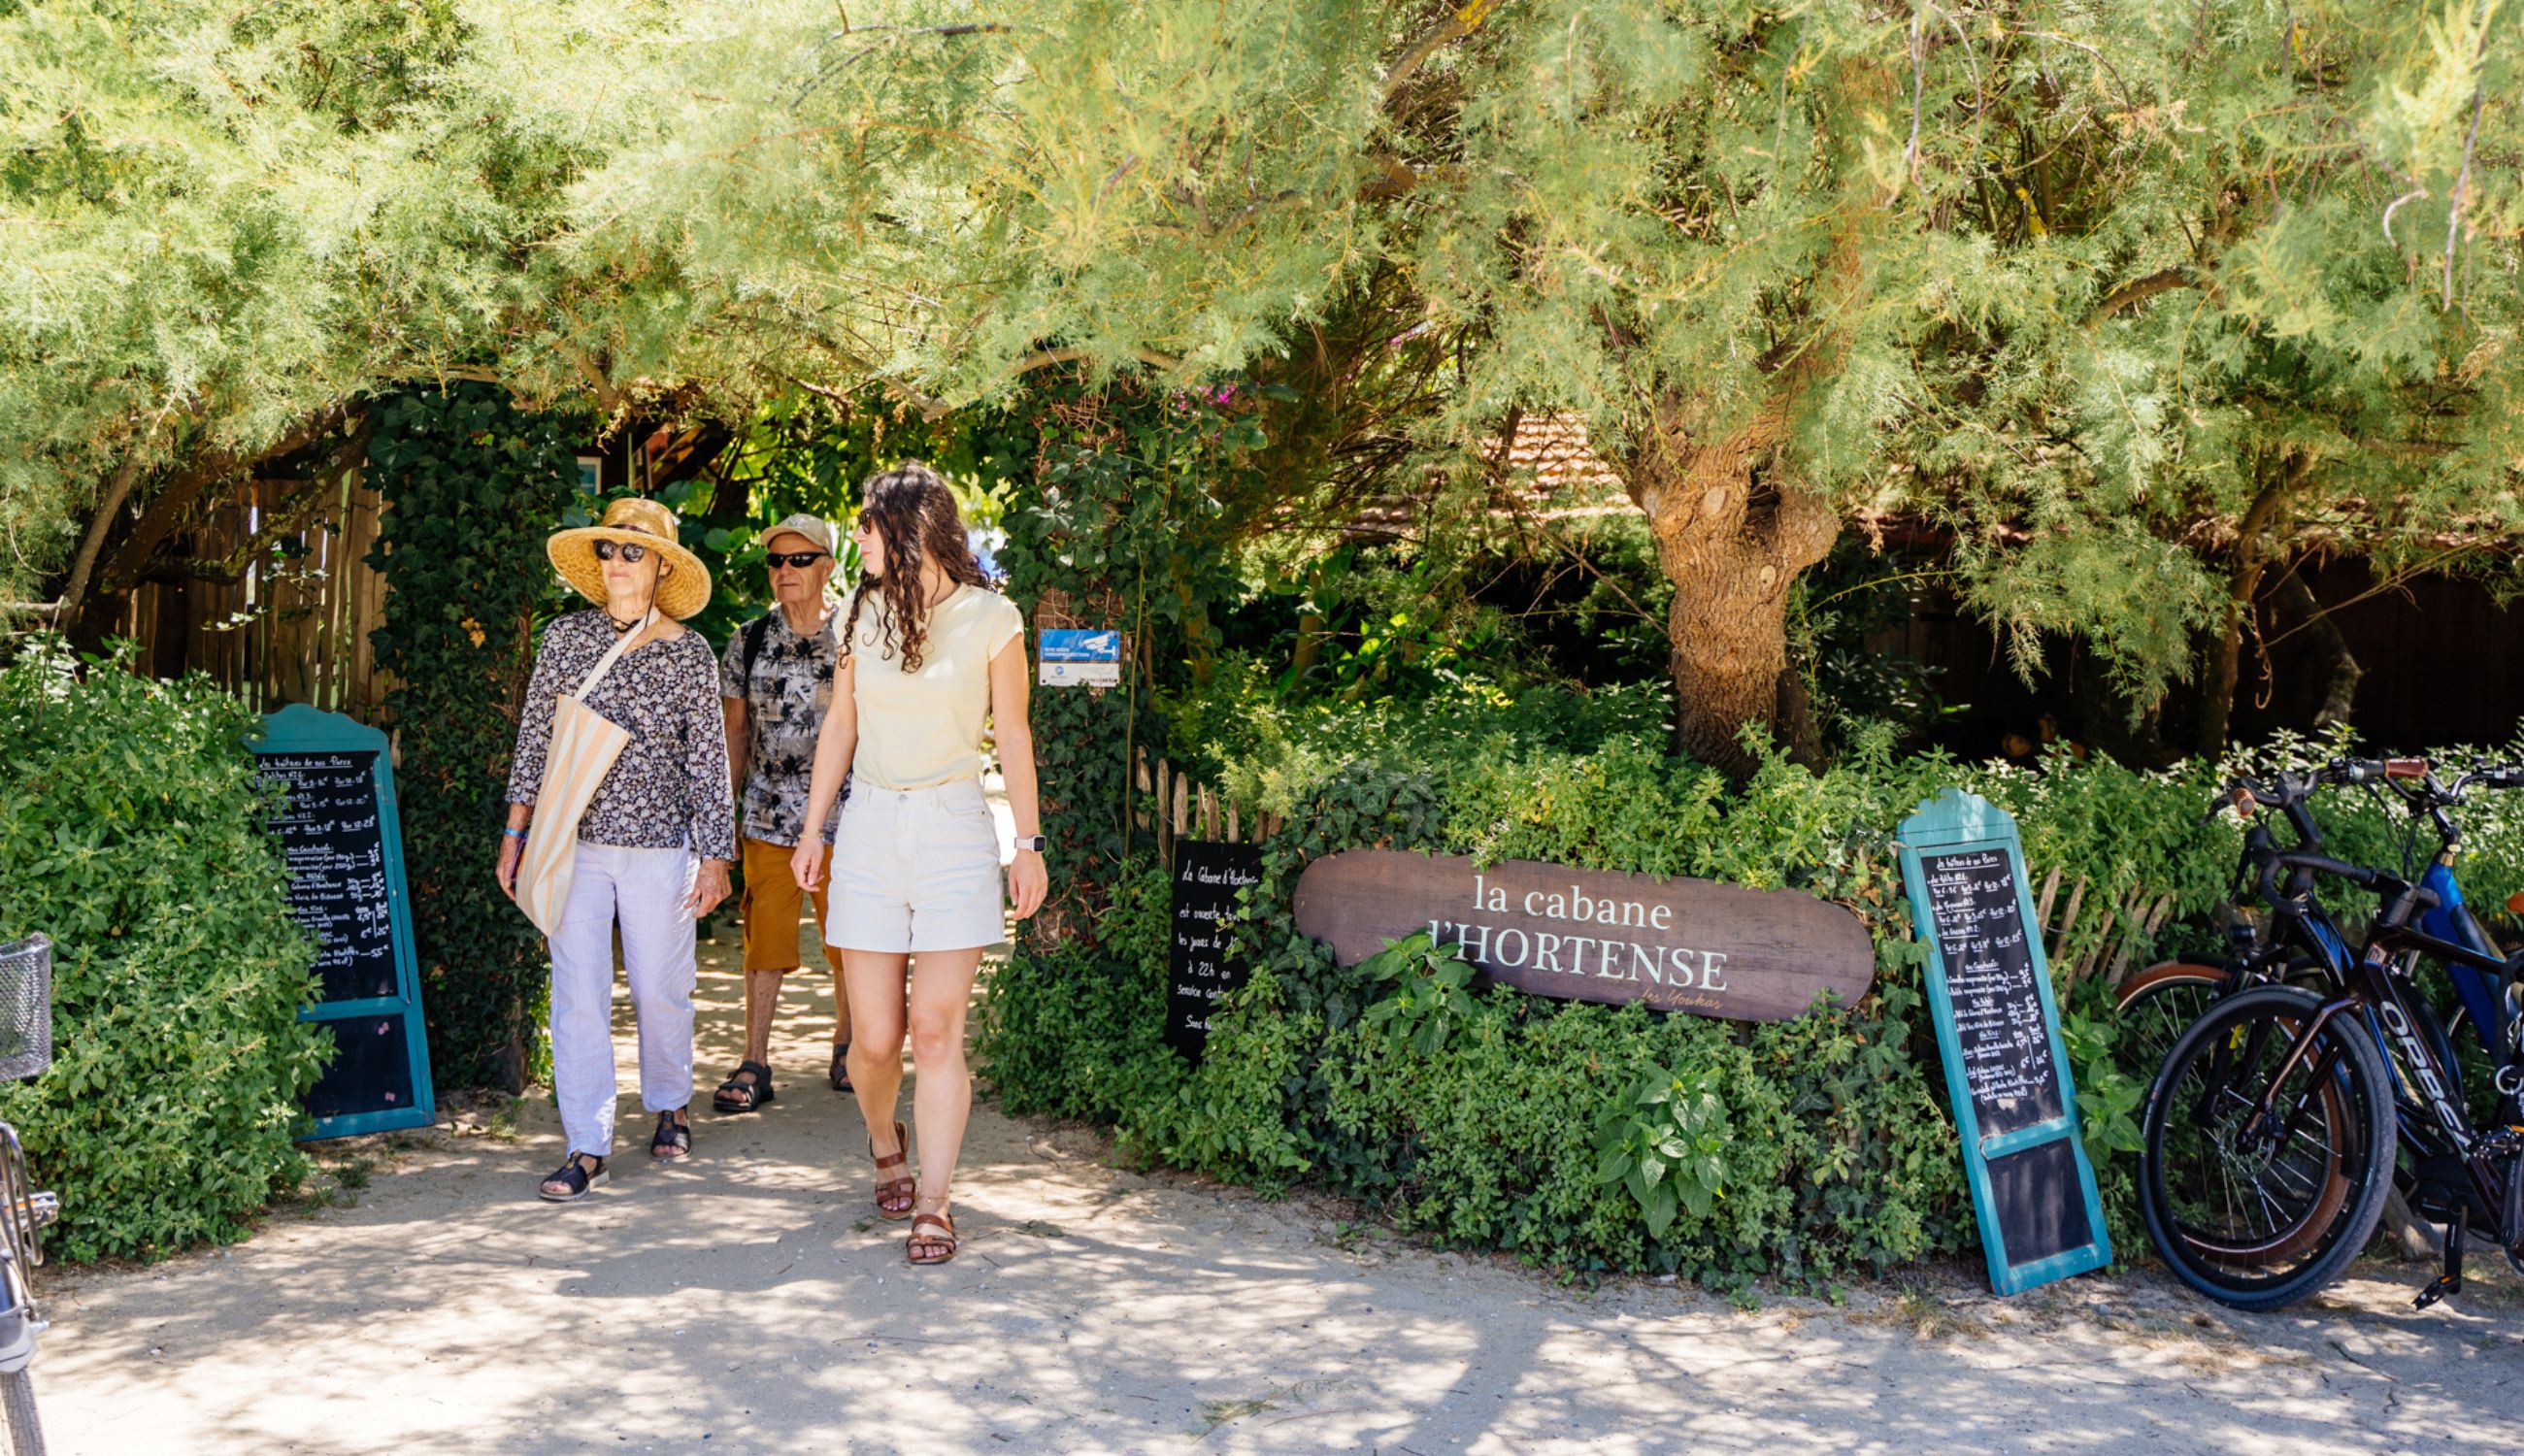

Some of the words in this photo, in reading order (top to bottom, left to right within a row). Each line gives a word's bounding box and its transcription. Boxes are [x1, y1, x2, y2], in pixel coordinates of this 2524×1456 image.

[1179, 902, 1190, 918] est
[1473, 875, 1509, 913] la
[1523, 884, 1673, 931] cabane
[1212, 934, 1222, 949] de
[1220, 970, 1232, 979] en
[2380, 1001, 2472, 1164] ORBEA
